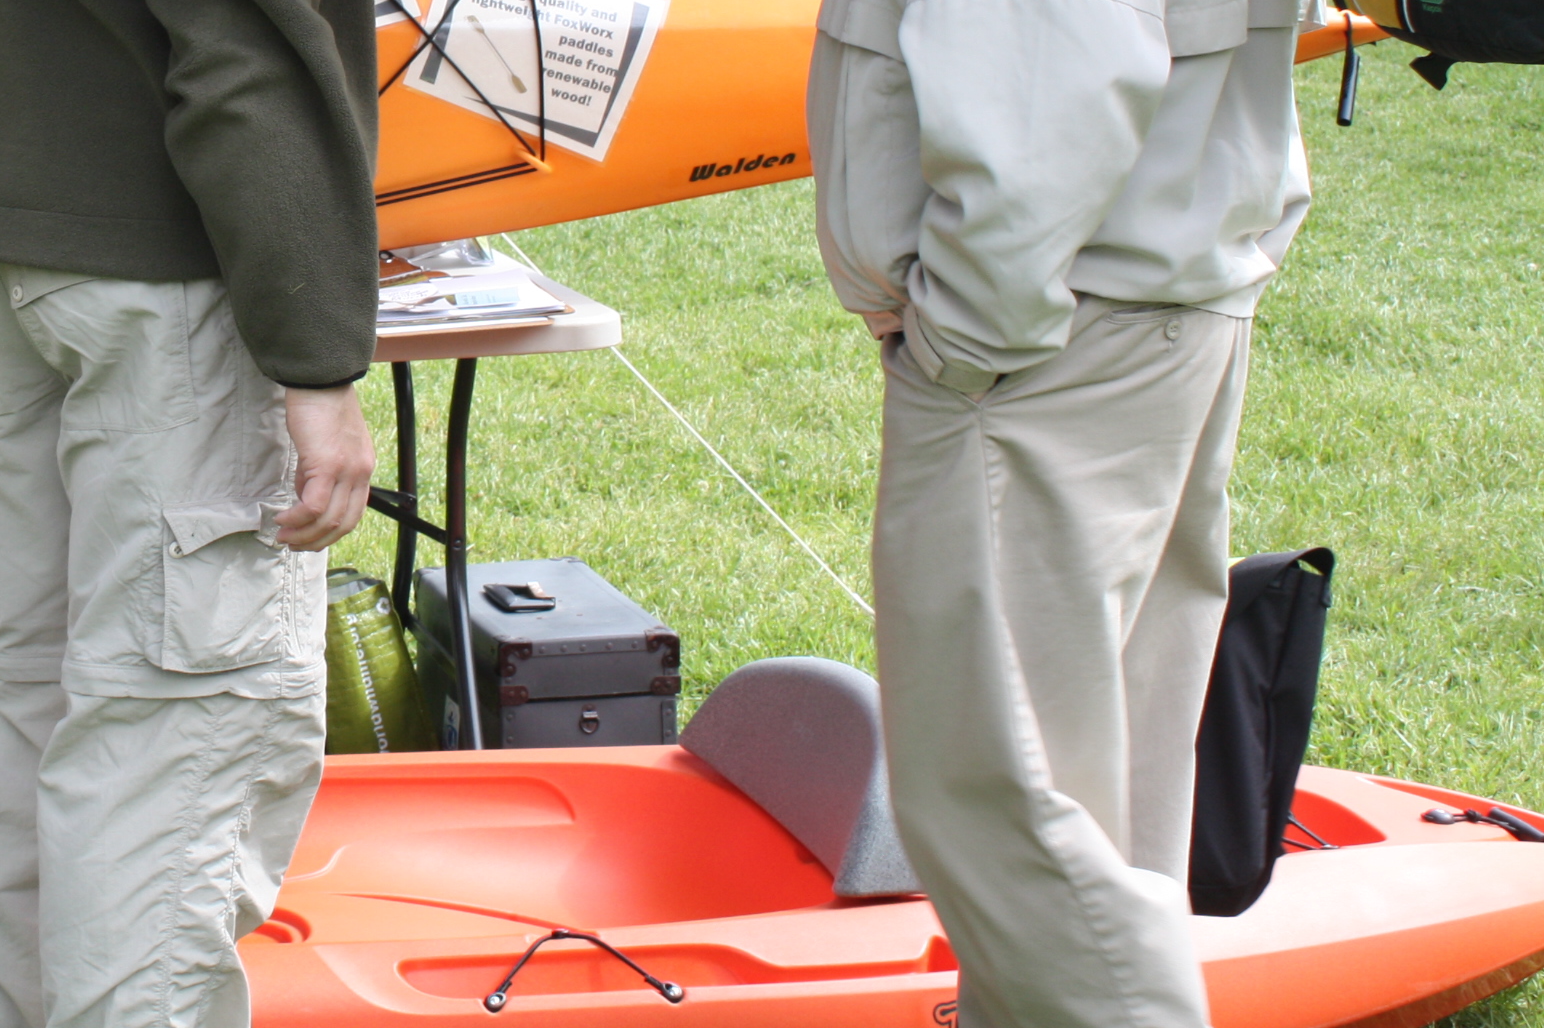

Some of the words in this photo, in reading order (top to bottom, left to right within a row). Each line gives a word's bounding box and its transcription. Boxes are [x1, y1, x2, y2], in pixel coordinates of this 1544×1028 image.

[554, 14, 614, 40] FoxWorx
[591, 8, 618, 22] and
[558, 35, 614, 58] paddles
[545, 49, 583, 68] made
[586, 59, 620, 78] from
[542, 67, 612, 94] renewable
[551, 87, 592, 107] wood!
[689, 152, 796, 182] Walden
